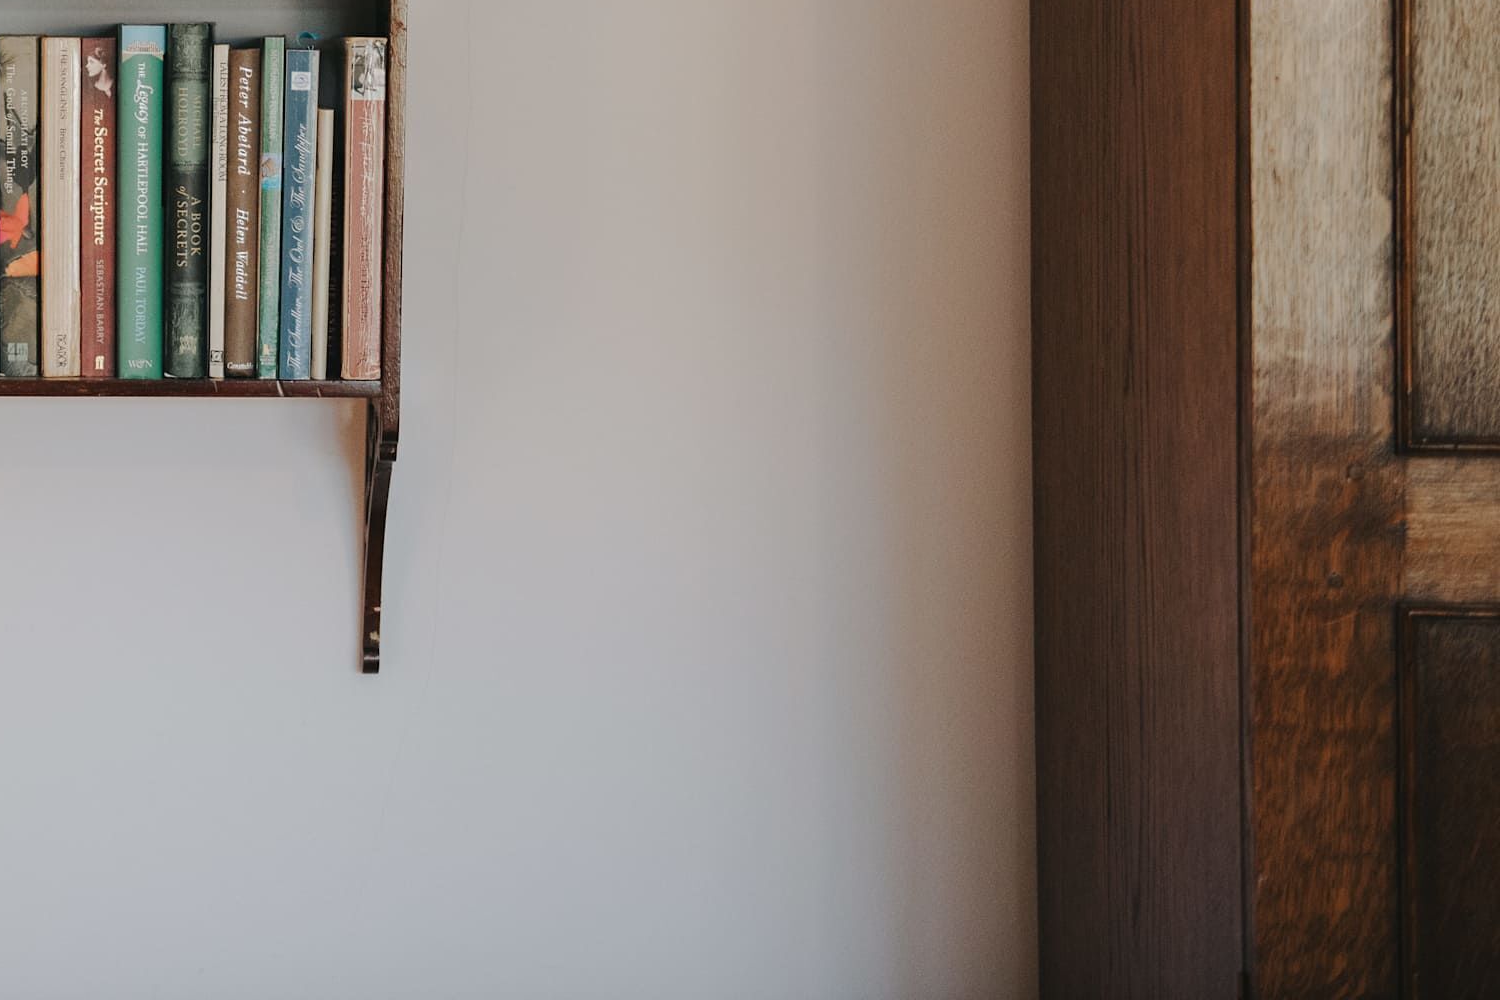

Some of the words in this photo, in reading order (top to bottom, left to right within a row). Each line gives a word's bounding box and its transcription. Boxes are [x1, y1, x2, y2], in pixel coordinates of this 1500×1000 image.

[6, 64, 16, 84] The
[137, 62, 146, 78] THE
[237, 66, 253, 108] Peter
[5, 88, 16, 110] God
[94, 108, 104, 125] The
[133, 80, 153, 124] Legacy
[4, 113, 15, 123] of
[19, 90, 28, 147] ARUNDHATI
[137, 126, 146, 140] OF
[177, 87, 189, 157] HOLROYD
[191, 94, 201, 149] MICHAEL
[5, 125, 16, 154] Small
[94, 127, 107, 173] Secret
[237, 113, 252, 176] Abelard
[291, 123, 312, 185] Sandpiper
[4, 158, 16, 194] Things
[19, 150, 28, 168] ROY
[136, 142, 148, 222] HARTLEPOOL
[176, 186, 190, 198] of
[290, 186, 307, 209] The
[90, 176, 107, 245] Scripture
[191, 197, 201, 207] A
[136, 226, 148, 256] HALL
[176, 200, 188, 267] SECRETS
[191, 212, 201, 257] BOOK
[235, 208, 249, 244] Helen
[95, 258, 104, 309] SEBASTIAN
[135, 266, 147, 294] PAUL
[234, 250, 249, 300] Waddell
[288, 266, 304, 289] The
[95, 311, 104, 344] BARRY
[134, 297, 146, 344] TORDAY
[287, 350, 304, 370] The
